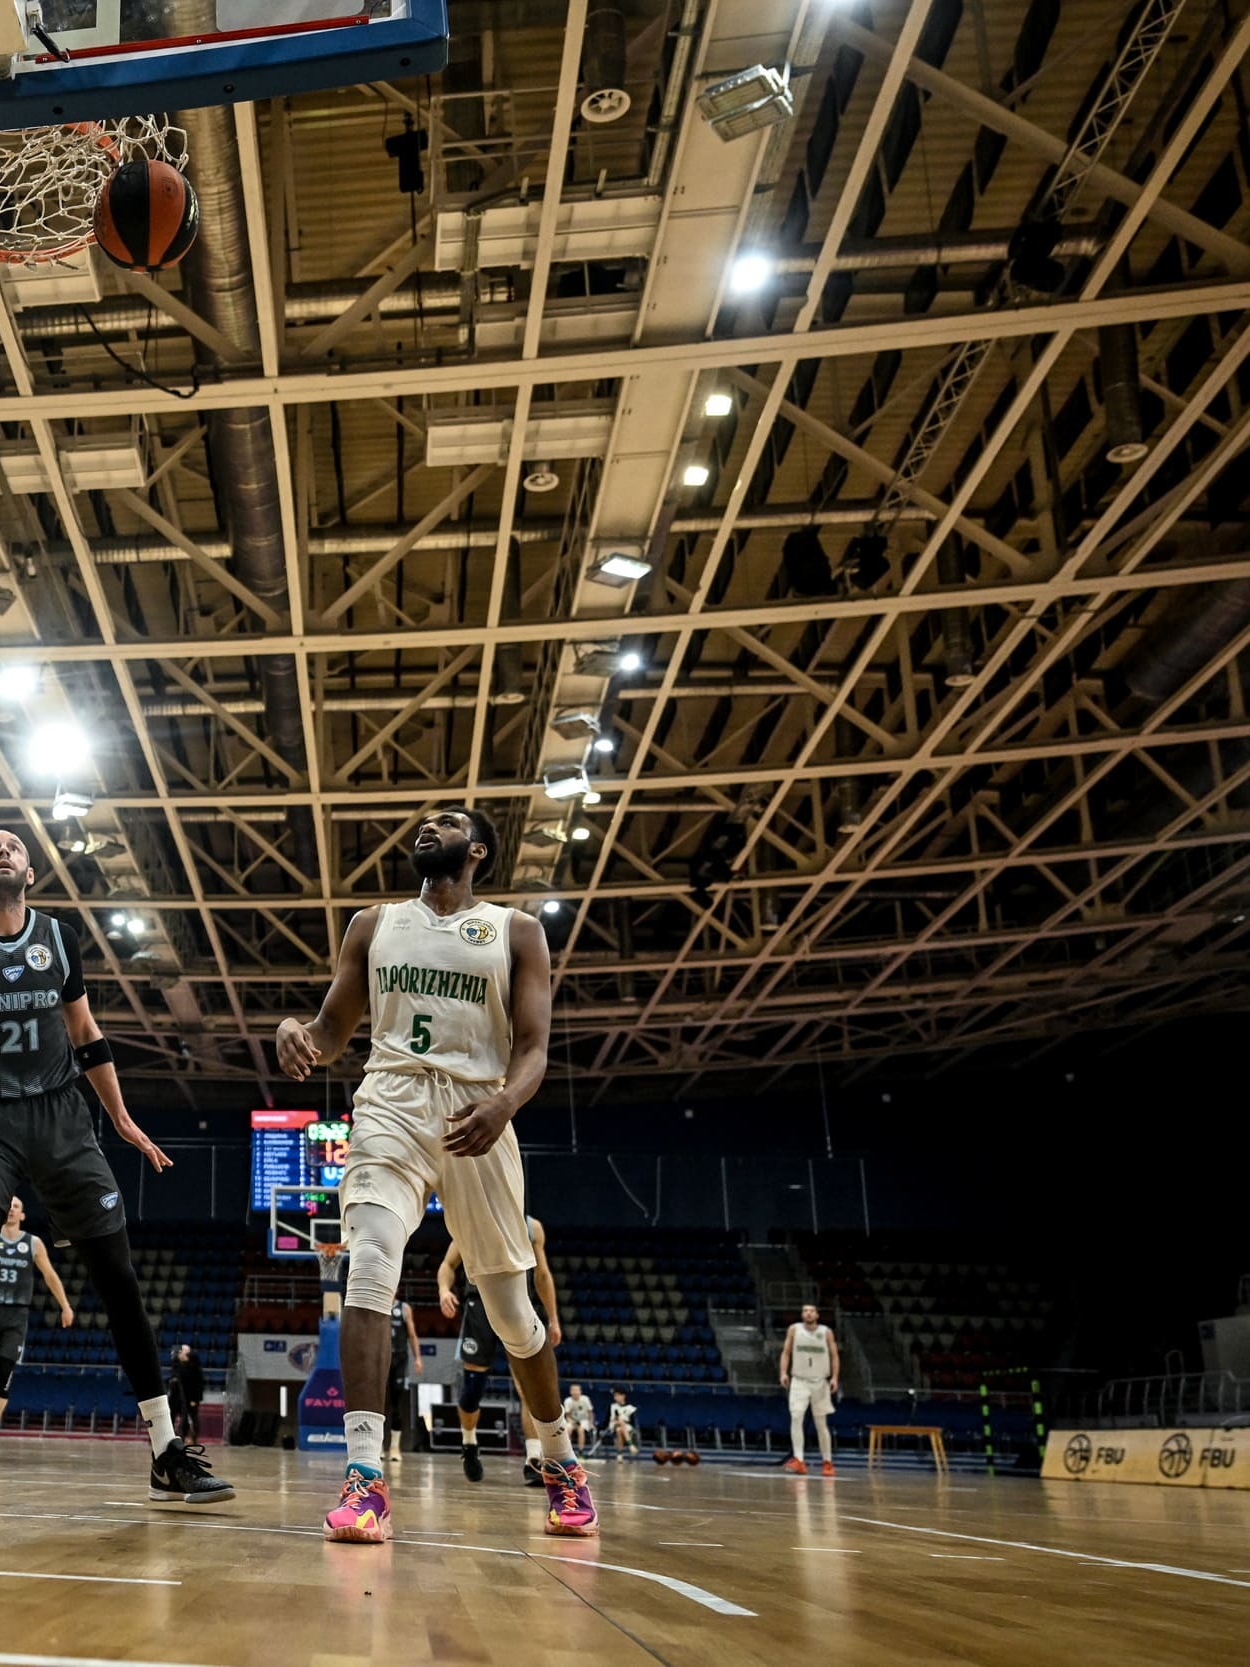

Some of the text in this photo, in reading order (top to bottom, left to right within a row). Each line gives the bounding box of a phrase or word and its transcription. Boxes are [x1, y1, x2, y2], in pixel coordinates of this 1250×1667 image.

[0, 1018, 40, 1054] 21
[410, 1014, 432, 1055] 5
[0, 1269, 18, 1283] 33
[1095, 1447, 1126, 1465] FBU
[1199, 1448, 1236, 1468] FBU
